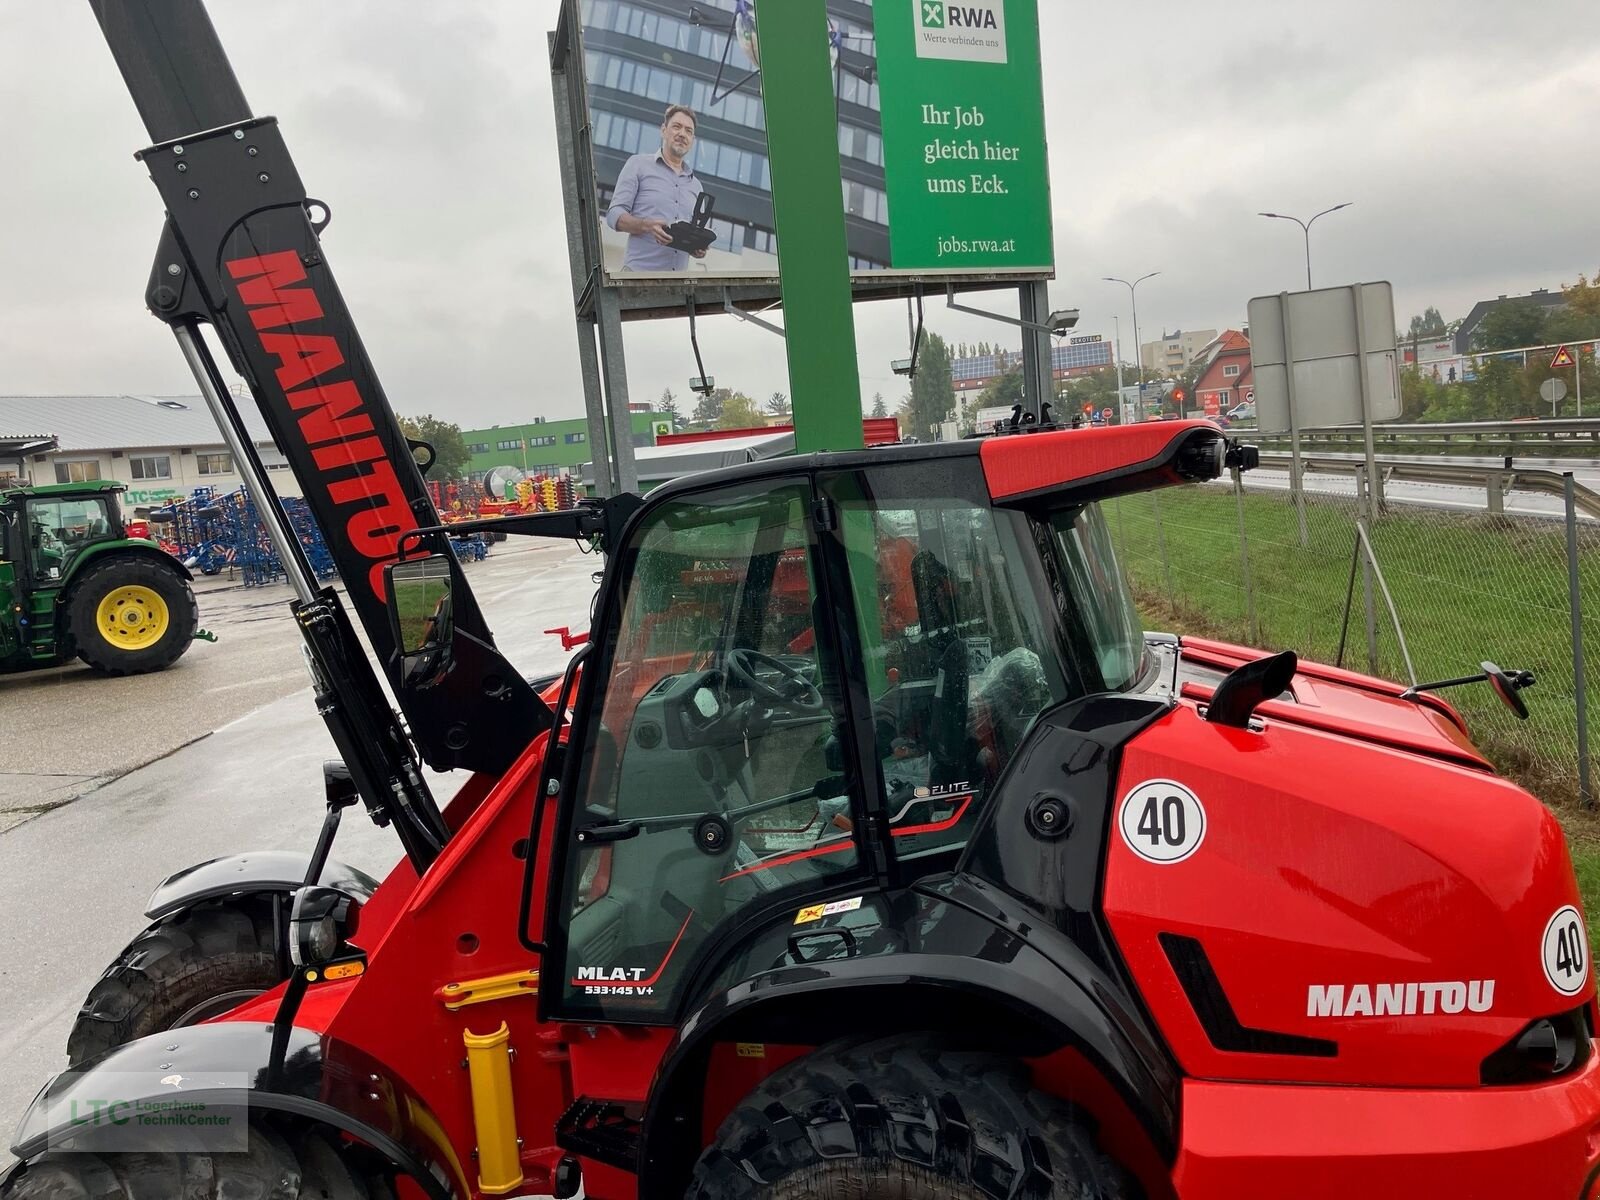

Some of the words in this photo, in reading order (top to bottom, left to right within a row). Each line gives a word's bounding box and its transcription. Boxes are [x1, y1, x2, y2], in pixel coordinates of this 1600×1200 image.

[948, 6, 997, 29] RWA
[923, 33, 947, 44] Werte
[948, 35, 984, 47] verbinden
[985, 39, 999, 48] uns
[922, 104, 950, 125] Ihr
[954, 106, 984, 130] Job
[924, 139, 980, 164] gleich
[984, 141, 1019, 161] hier
[927, 177, 966, 194] ums
[971, 174, 1009, 195] Eck.
[938, 236, 1016, 257] jobs.rwa.at
[124, 490, 148, 505] LTC
[932, 781, 971, 795] ELITE
[1137, 796, 1185, 847] 40
[1556, 921, 1584, 978] 40
[577, 966, 646, 981] MLA-T
[584, 986, 633, 995] 533-145
[636, 986, 654, 996] V+
[1307, 980, 1495, 1017] MANITOU
